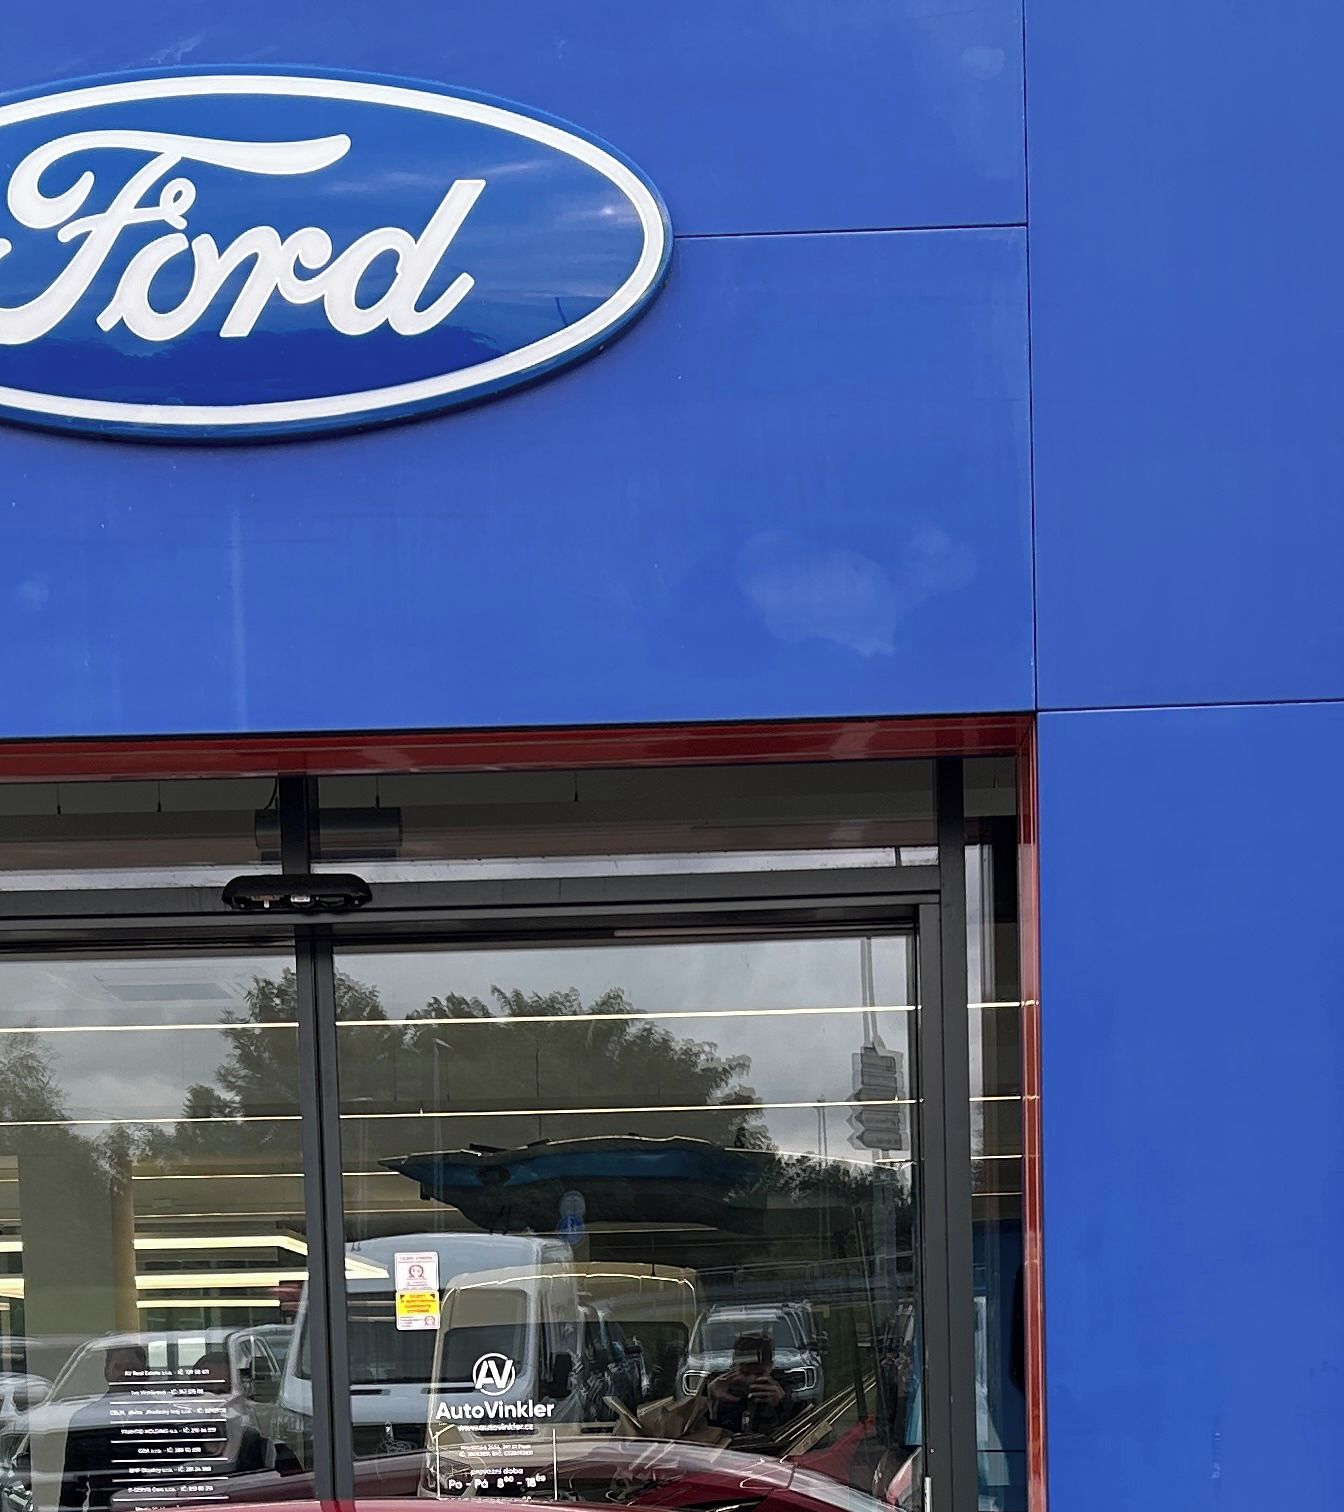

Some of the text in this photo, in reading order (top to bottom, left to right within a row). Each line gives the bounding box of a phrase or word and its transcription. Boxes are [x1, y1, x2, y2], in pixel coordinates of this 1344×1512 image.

[435, 1399, 555, 1420] AutoVinkler
[502, 1467, 524, 1475] doba
[448, 1479, 463, 1490] Po
